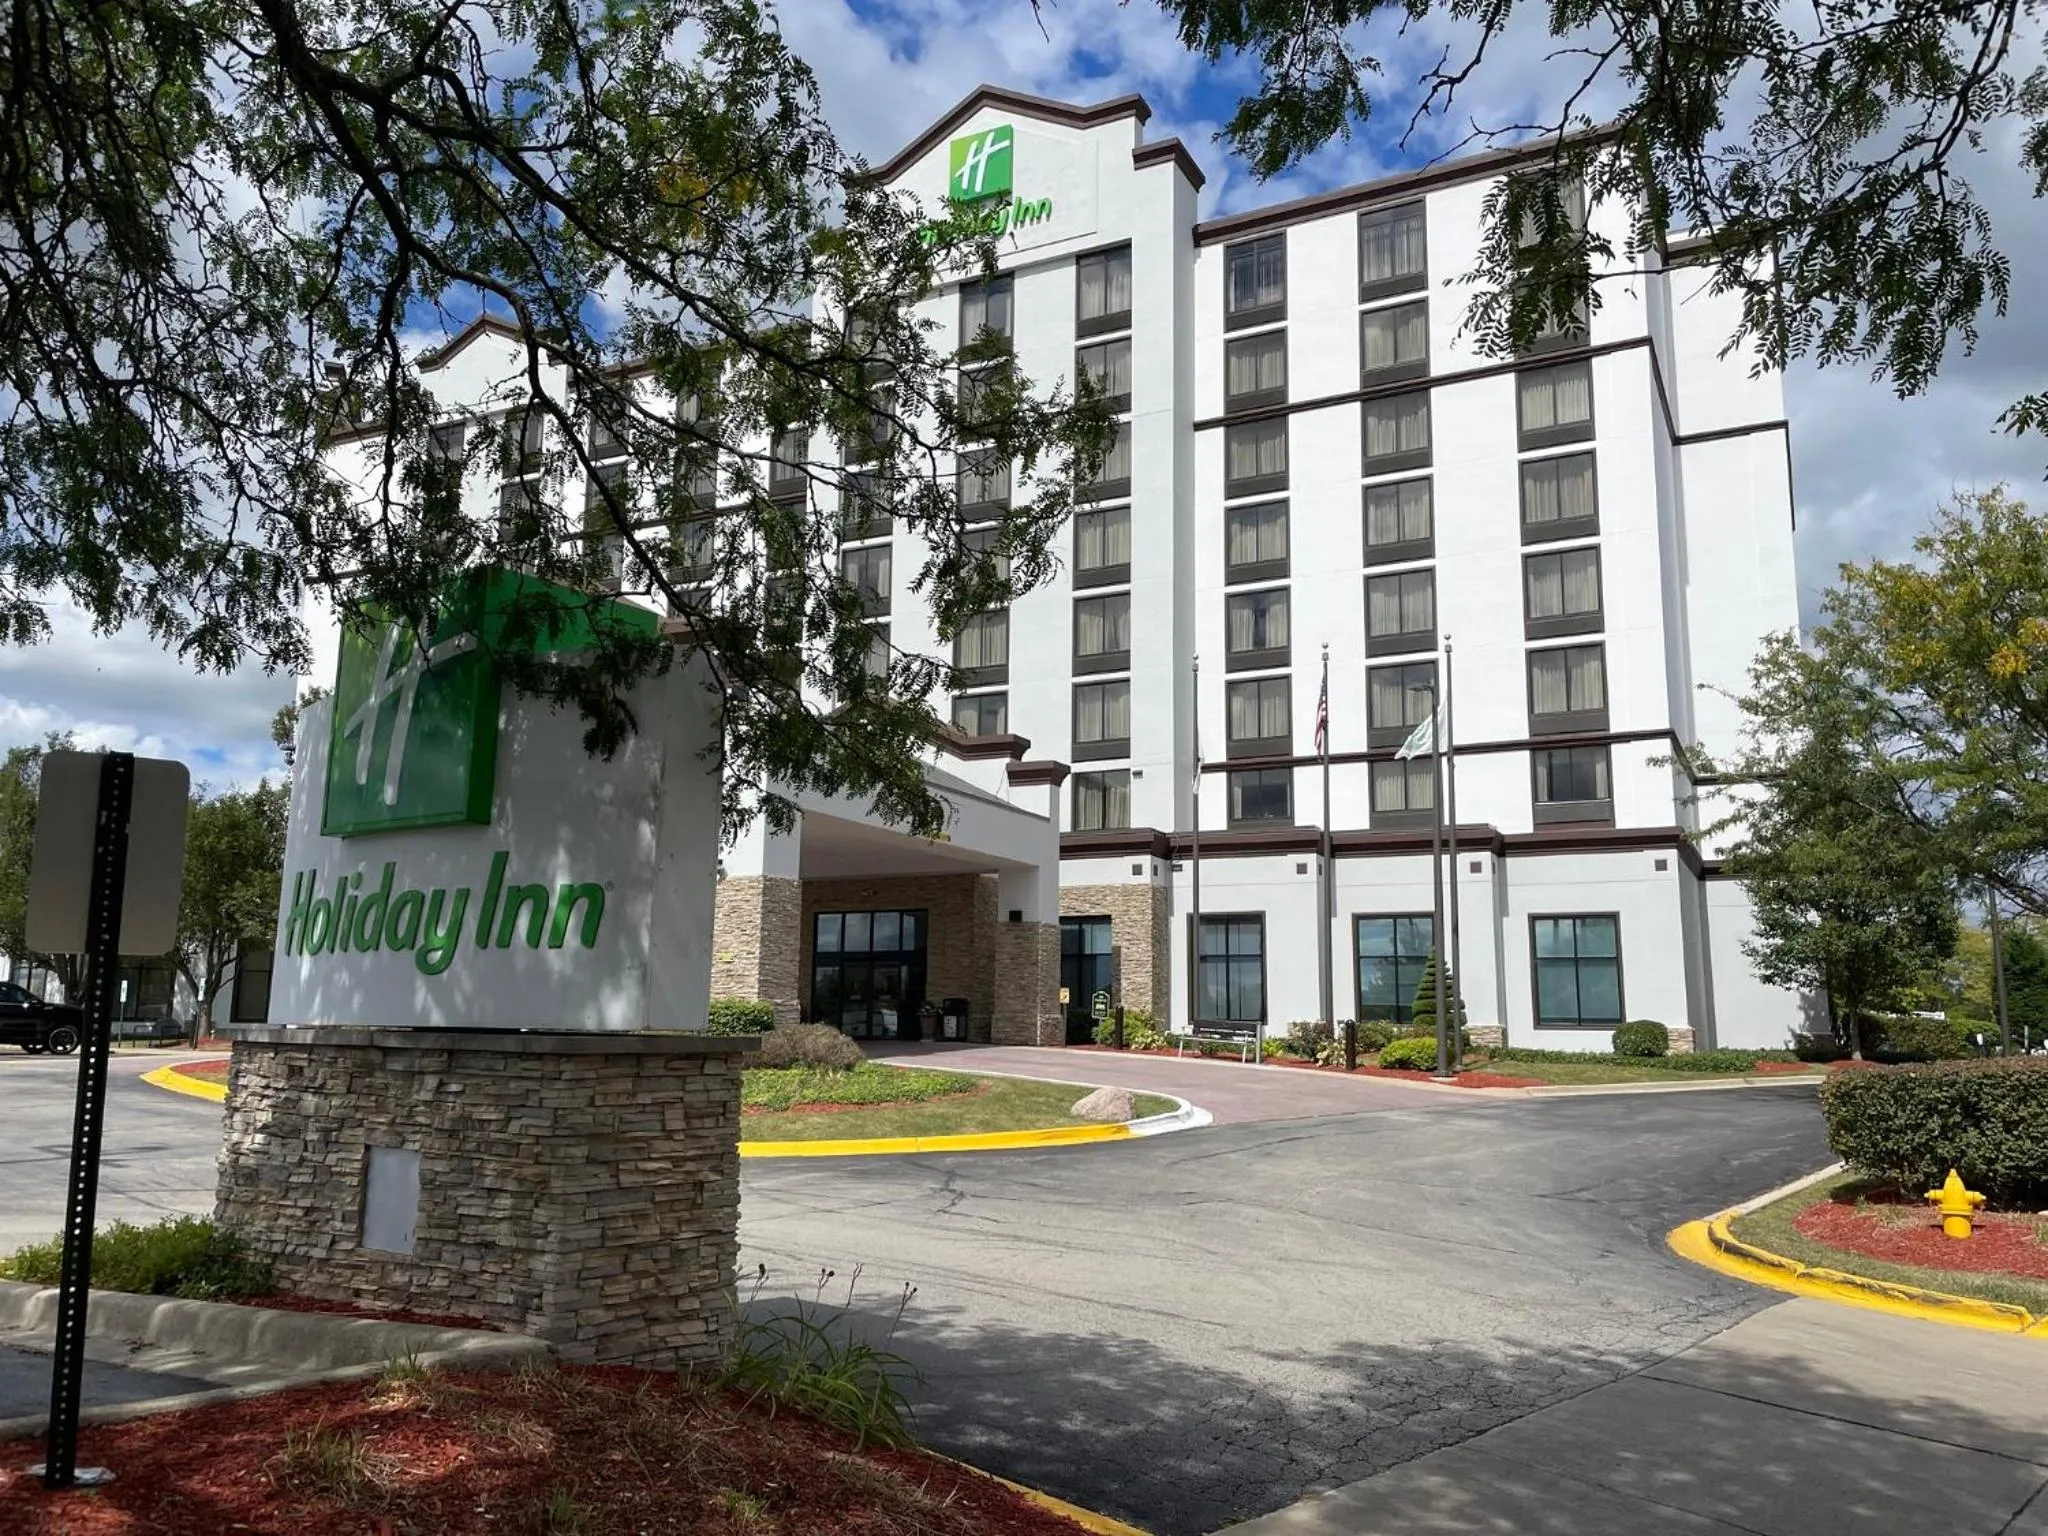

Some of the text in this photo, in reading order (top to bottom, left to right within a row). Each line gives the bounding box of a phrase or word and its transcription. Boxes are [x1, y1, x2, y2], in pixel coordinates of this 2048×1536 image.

[1010, 196, 1052, 229] Inn
[284, 851, 606, 976] Holiday Inn
